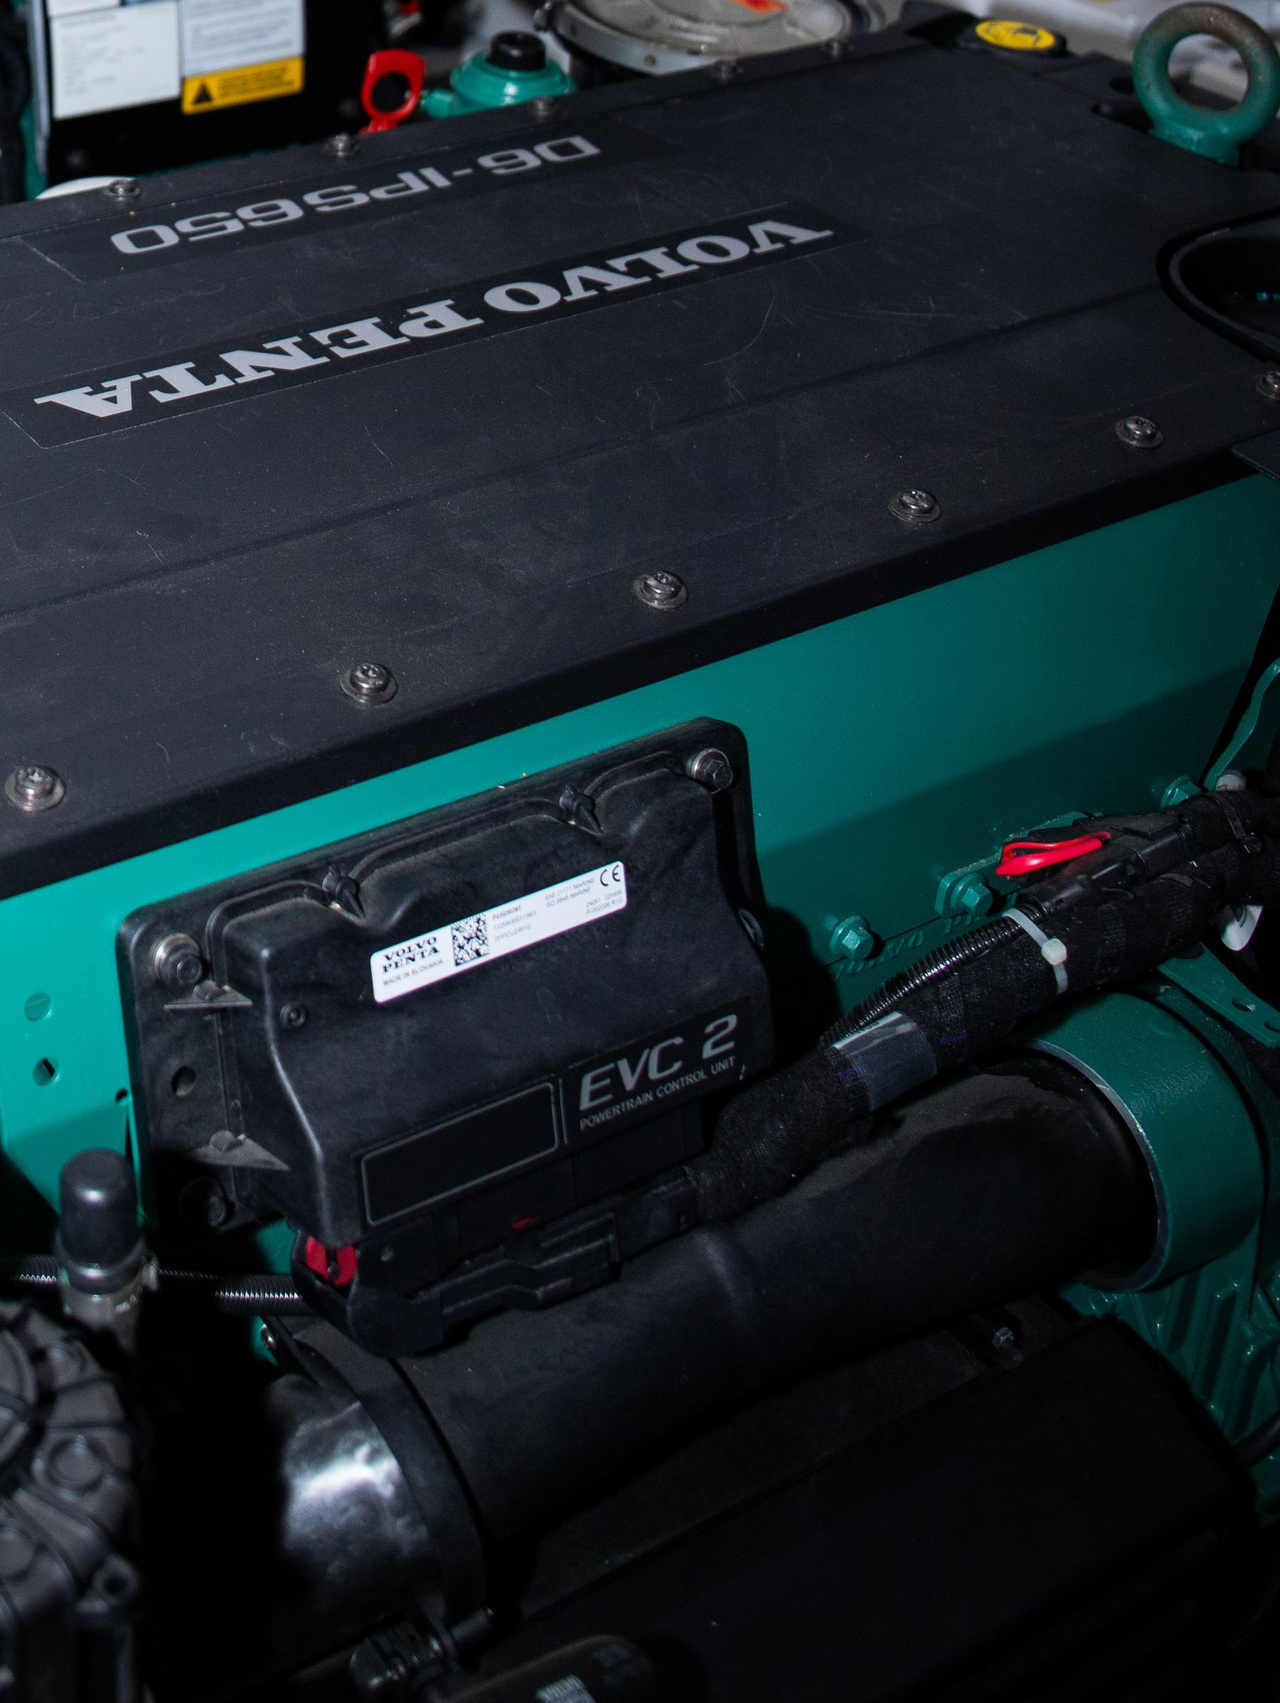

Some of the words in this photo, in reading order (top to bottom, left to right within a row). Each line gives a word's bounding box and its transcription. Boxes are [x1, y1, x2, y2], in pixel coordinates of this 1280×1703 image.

[110, 134, 601, 255] D6-IPS650
[483, 219, 835, 313] VOLVO
[33, 298, 485, 419] PENTA
[382, 946, 440, 973] PENTA
[383, 935, 438, 961] VOLVO
[579, 1035, 685, 1112] EVC
[701, 1013, 738, 1060] 2
[579, 1090, 654, 1131] POWERTRAIN
[656, 1068, 709, 1098] CONTROL
[710, 1055, 737, 1076] UNIT
